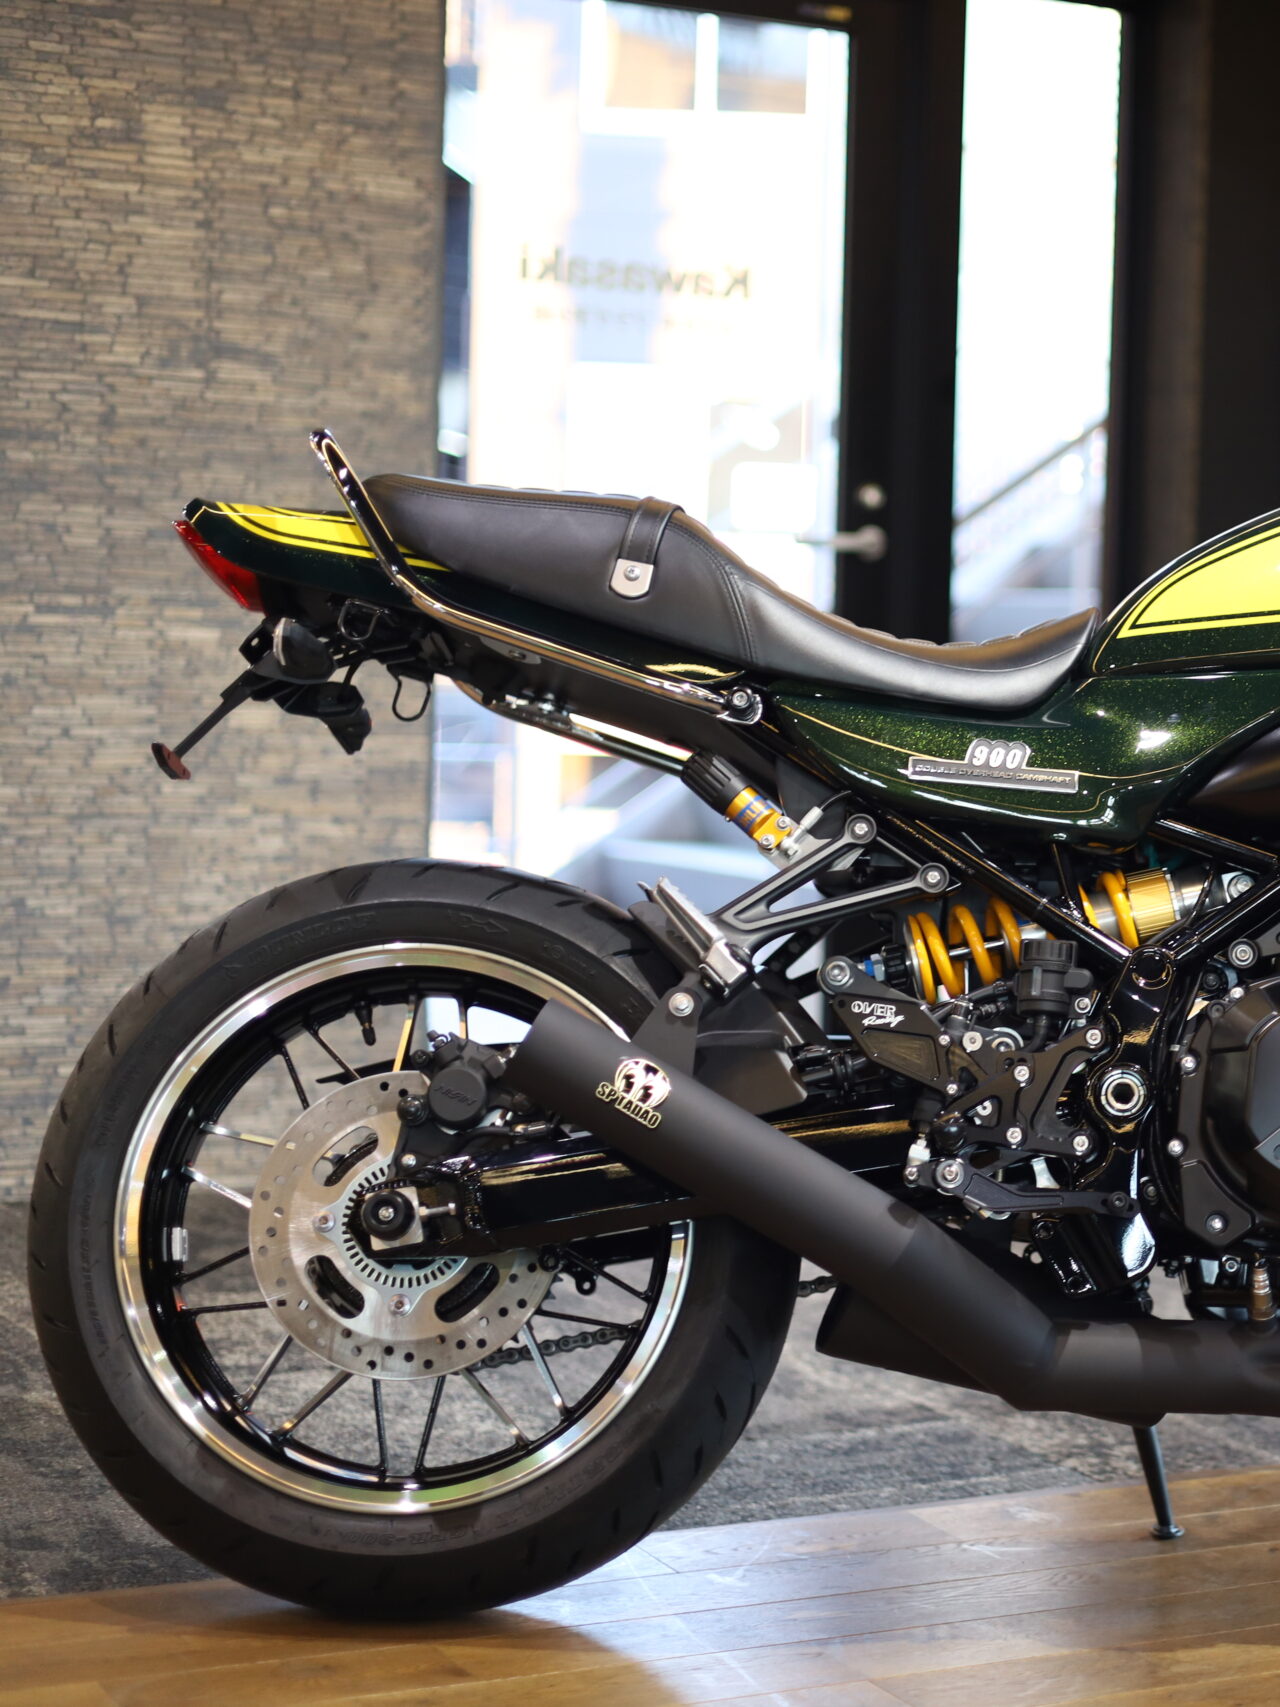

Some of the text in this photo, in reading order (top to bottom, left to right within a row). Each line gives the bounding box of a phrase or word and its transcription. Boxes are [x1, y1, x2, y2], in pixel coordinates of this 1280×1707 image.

[972, 745, 1024, 769] 900
[958, 767, 1014, 779] OVERHEAD
[1015, 772, 1072, 784] CAMSHAFT
[851, 1000, 896, 1017] OVER
[596, 1082, 661, 1128] SP TADAO
